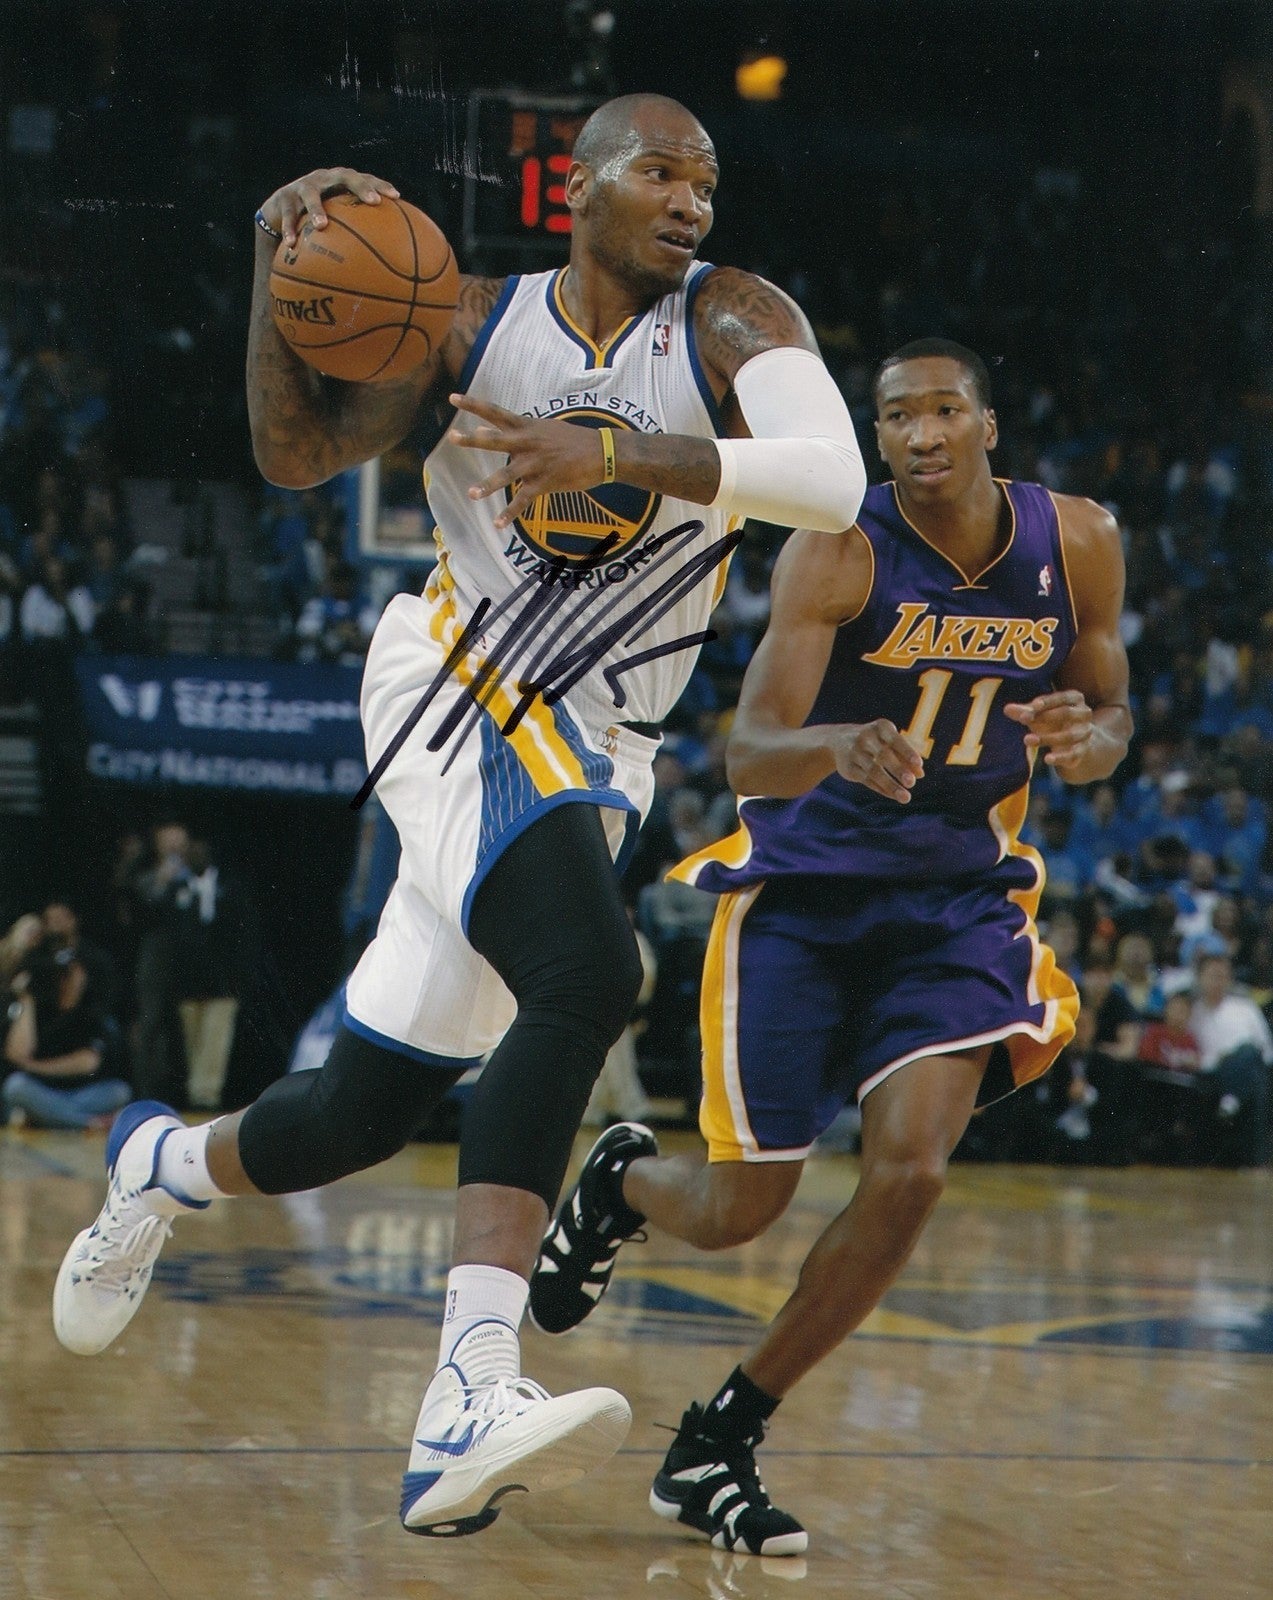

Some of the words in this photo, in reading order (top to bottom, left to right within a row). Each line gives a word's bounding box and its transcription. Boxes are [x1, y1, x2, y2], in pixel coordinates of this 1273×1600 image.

[275, 296, 337, 327] SPALD
[521, 392, 598, 419] LDEN
[607, 396, 665, 434] STAT
[860, 602, 1059, 670] LAKERS
[900, 668, 1003, 766] 11
